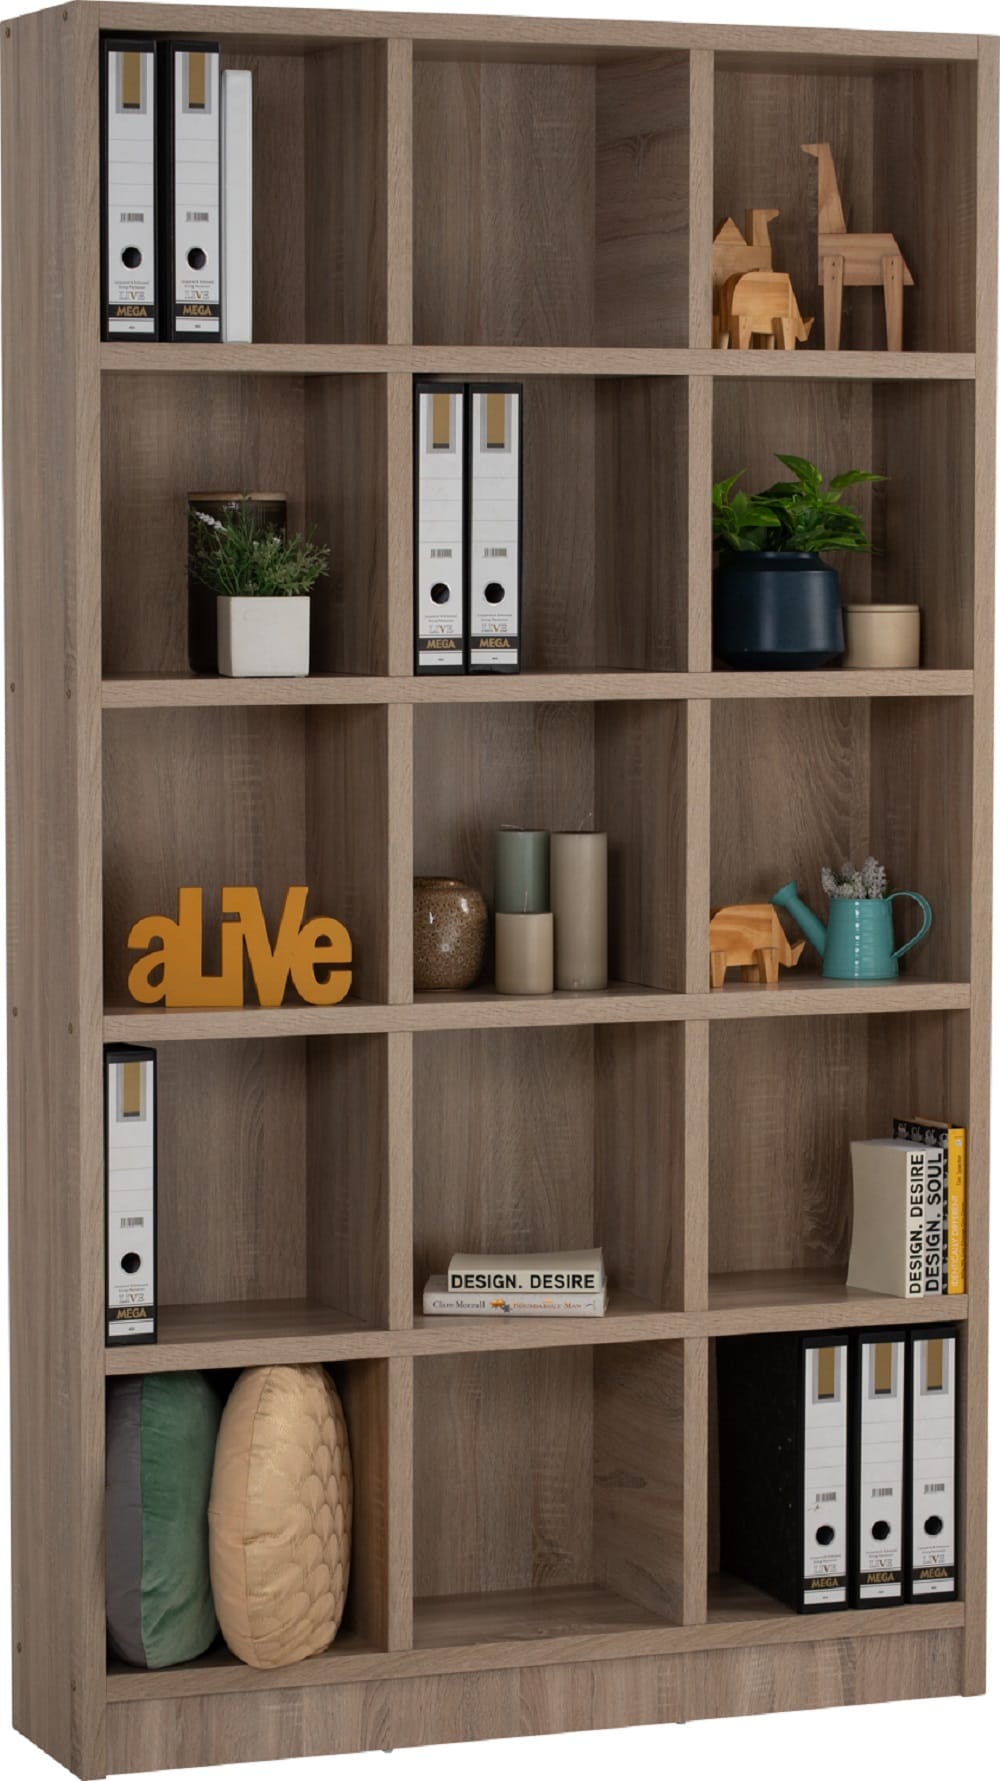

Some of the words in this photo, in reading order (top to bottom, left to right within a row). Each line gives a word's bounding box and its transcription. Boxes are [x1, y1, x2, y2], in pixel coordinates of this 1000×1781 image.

[117, 305, 147, 317] MEGA
[183, 304, 212, 316] MEGA
[427, 639, 456, 649] MEGA
[480, 638, 511, 648] MEGA
[927, 1153, 942, 1206] SOUL
[910, 1154, 924, 1218] DESIRE
[925, 1213, 941, 1292] DESIGN.
[909, 1224, 923, 1294] DESIGN.
[451, 1274, 523, 1289] DESIGN.
[530, 1274, 595, 1289] DESIRE
[116, 1307, 147, 1319] MEGA
[867, 1572, 896, 1584] MEGA
[920, 1567, 948, 1579] MEGA
[811, 1577, 839, 1589] MEGA
